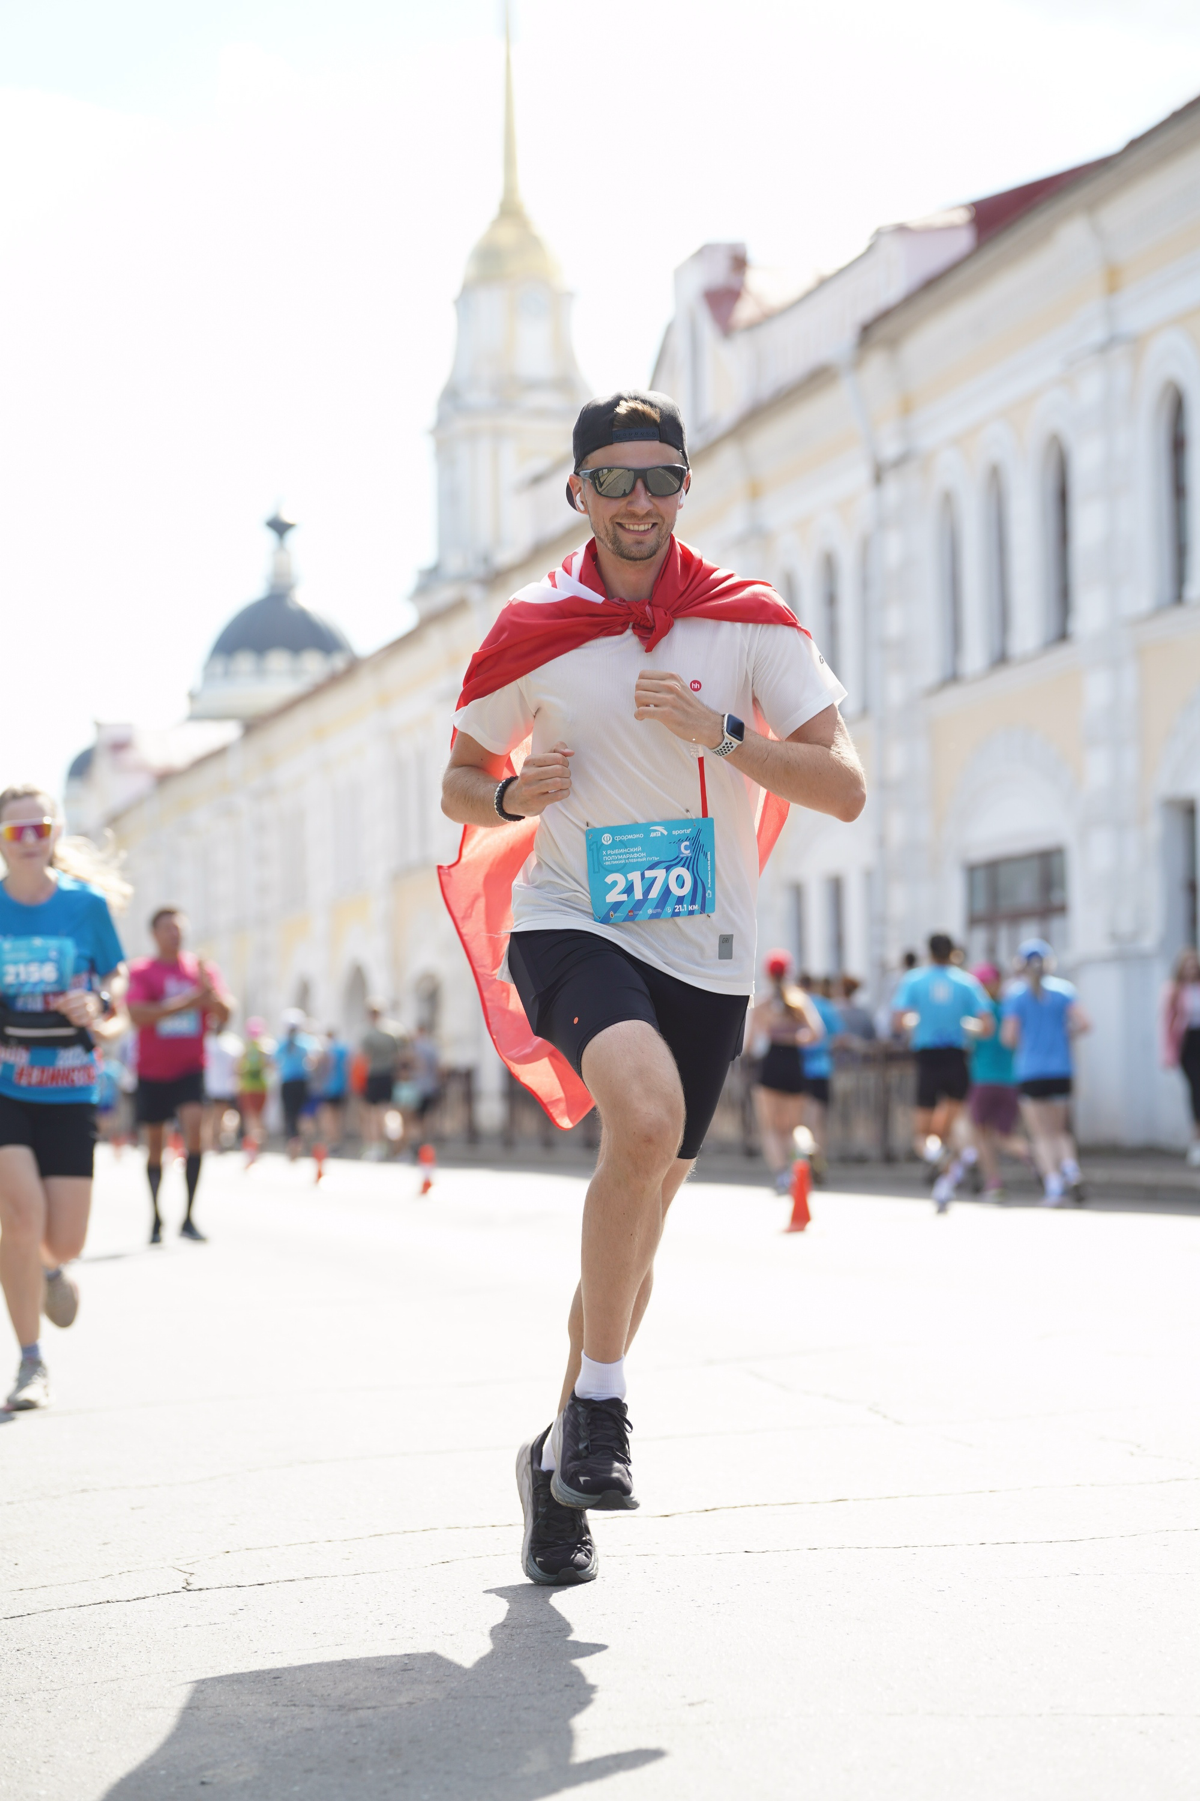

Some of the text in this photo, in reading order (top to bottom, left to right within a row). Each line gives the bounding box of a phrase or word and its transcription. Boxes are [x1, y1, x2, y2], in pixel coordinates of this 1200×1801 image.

[691, 682, 700, 690] hh
[607, 846, 642, 855] РЫБИНСКИЙ
[603, 852, 646, 861] ПОЛУМАРАФОН
[605, 867, 692, 903] 2170
[674, 904, 687, 912] 21.1
[3, 962, 58, 984] 2156
